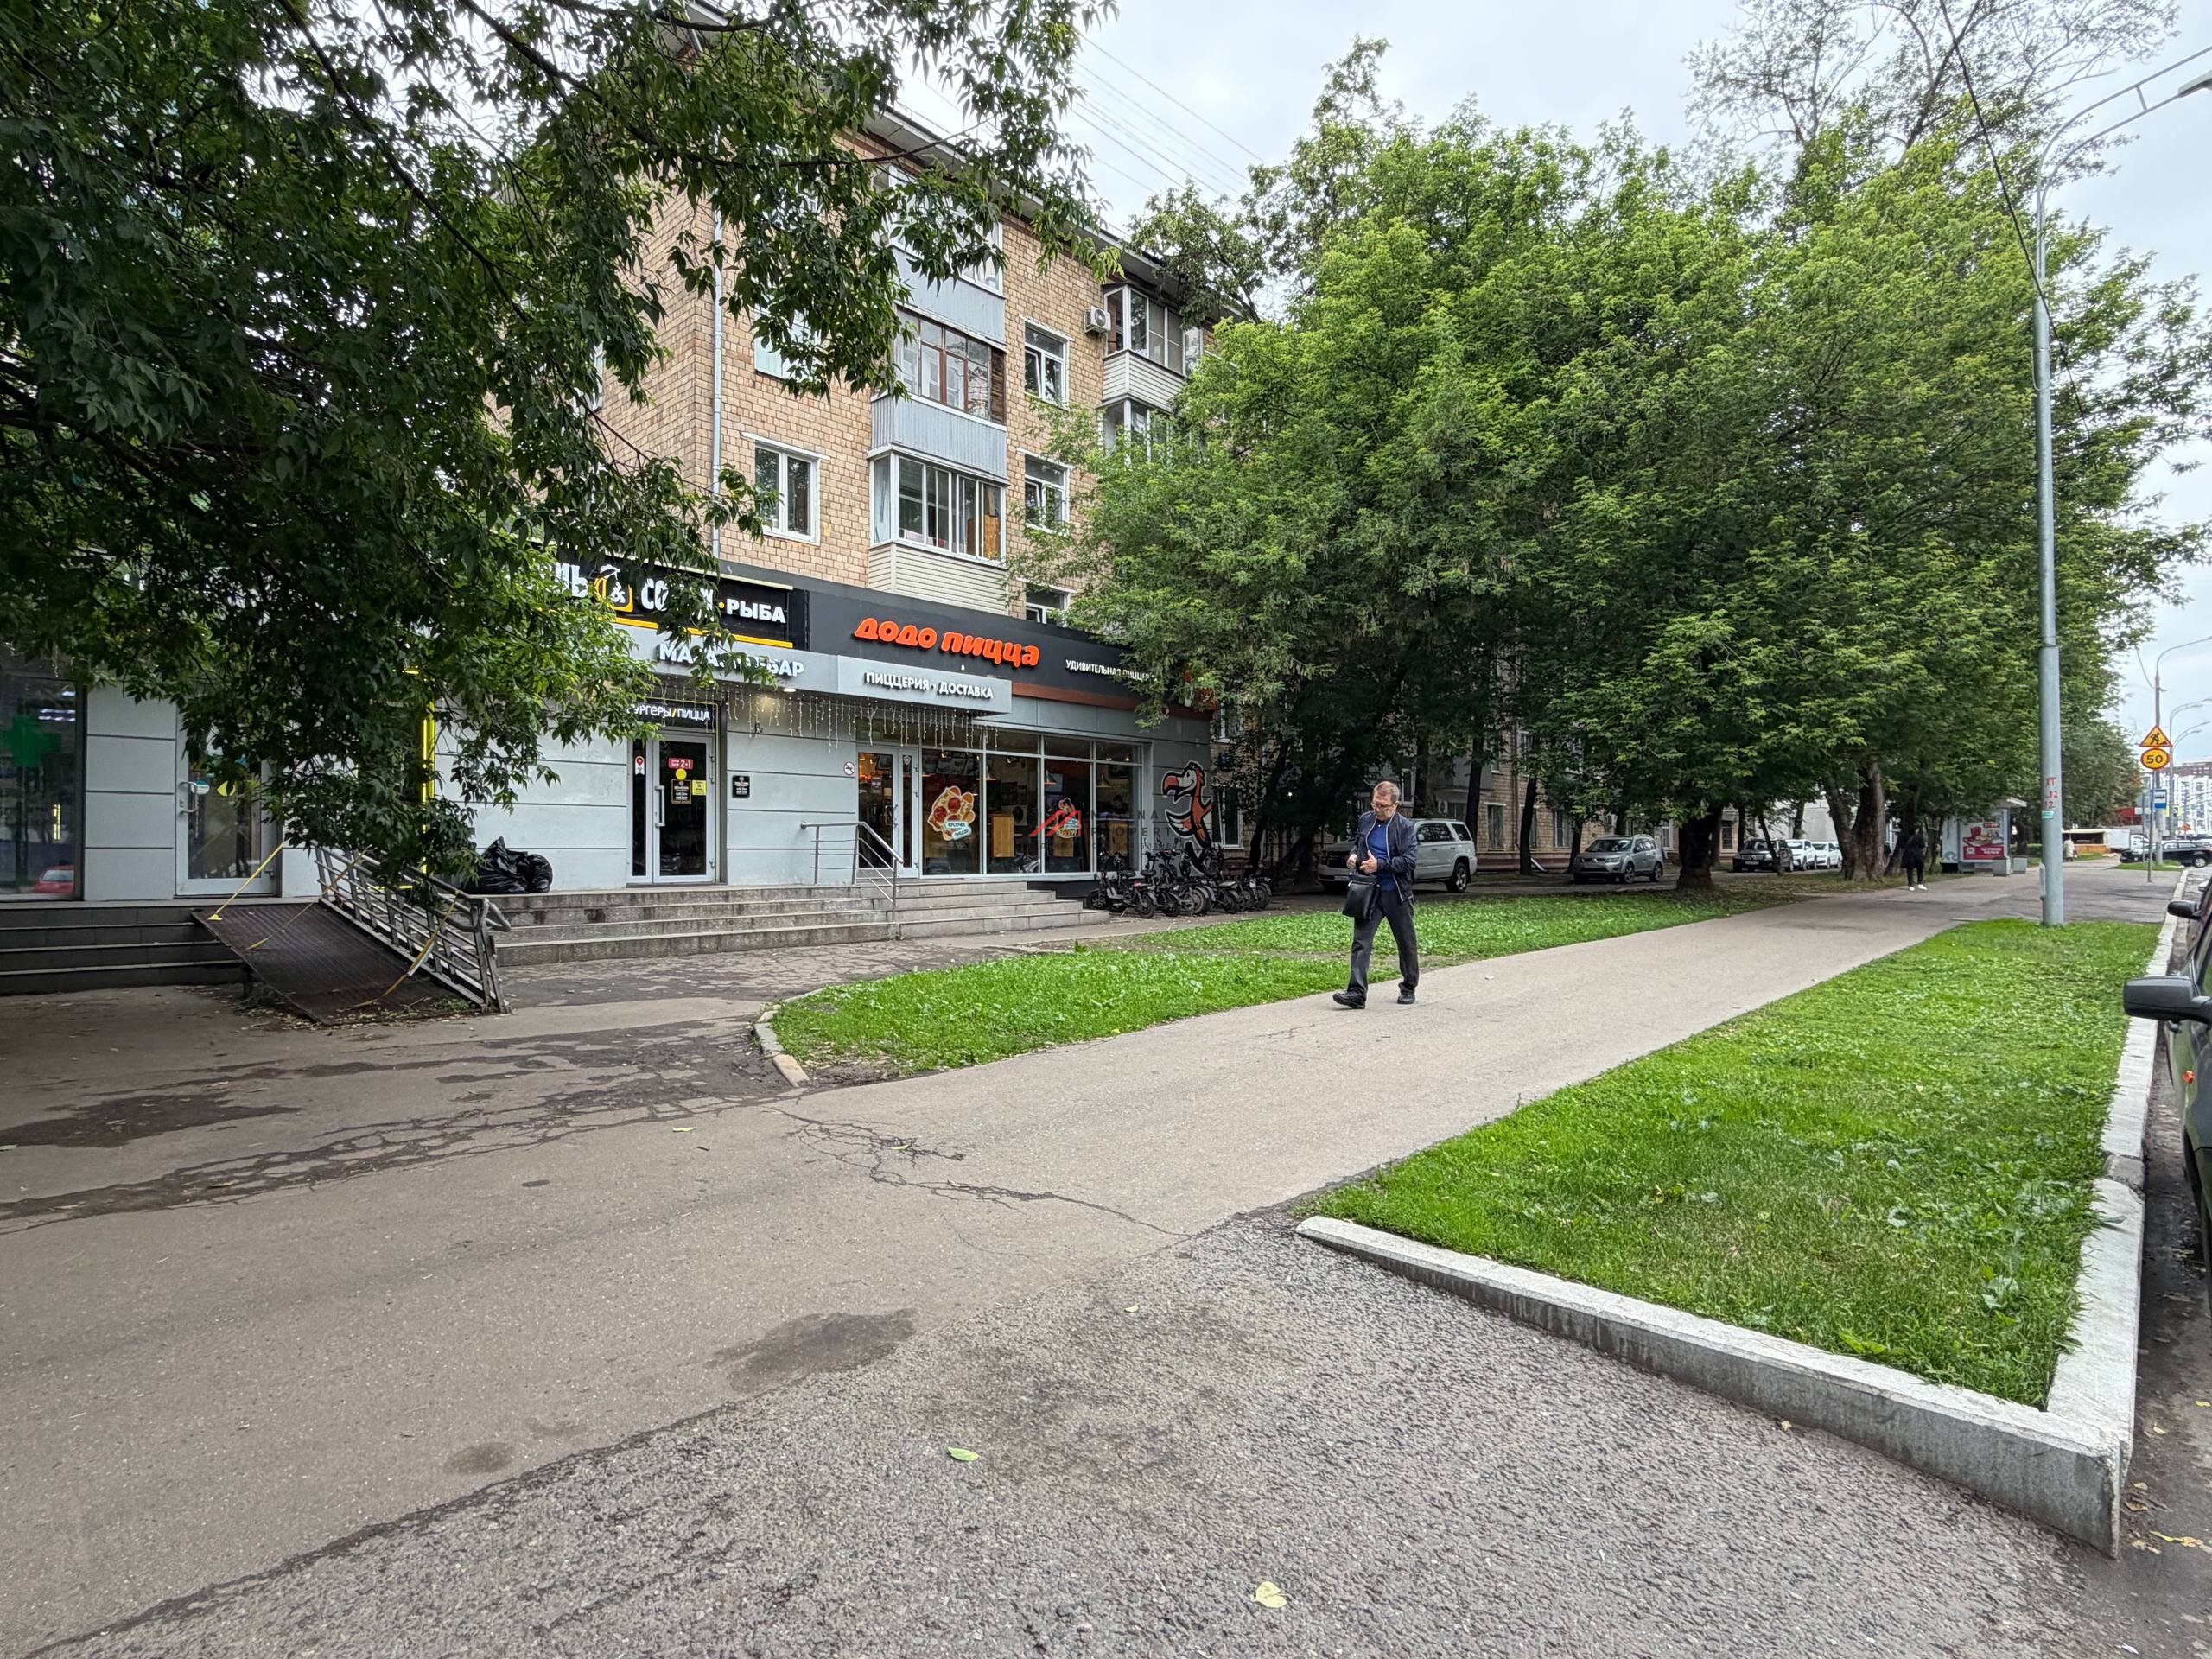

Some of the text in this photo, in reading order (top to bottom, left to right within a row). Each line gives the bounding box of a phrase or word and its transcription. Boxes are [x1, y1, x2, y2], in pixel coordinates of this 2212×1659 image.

[726, 598, 786, 624] РЫБА
[866, 671, 994, 699] ПИЦЦЕРИЯ ДОСТАВКА
[2145, 754, 2164, 764] 50
